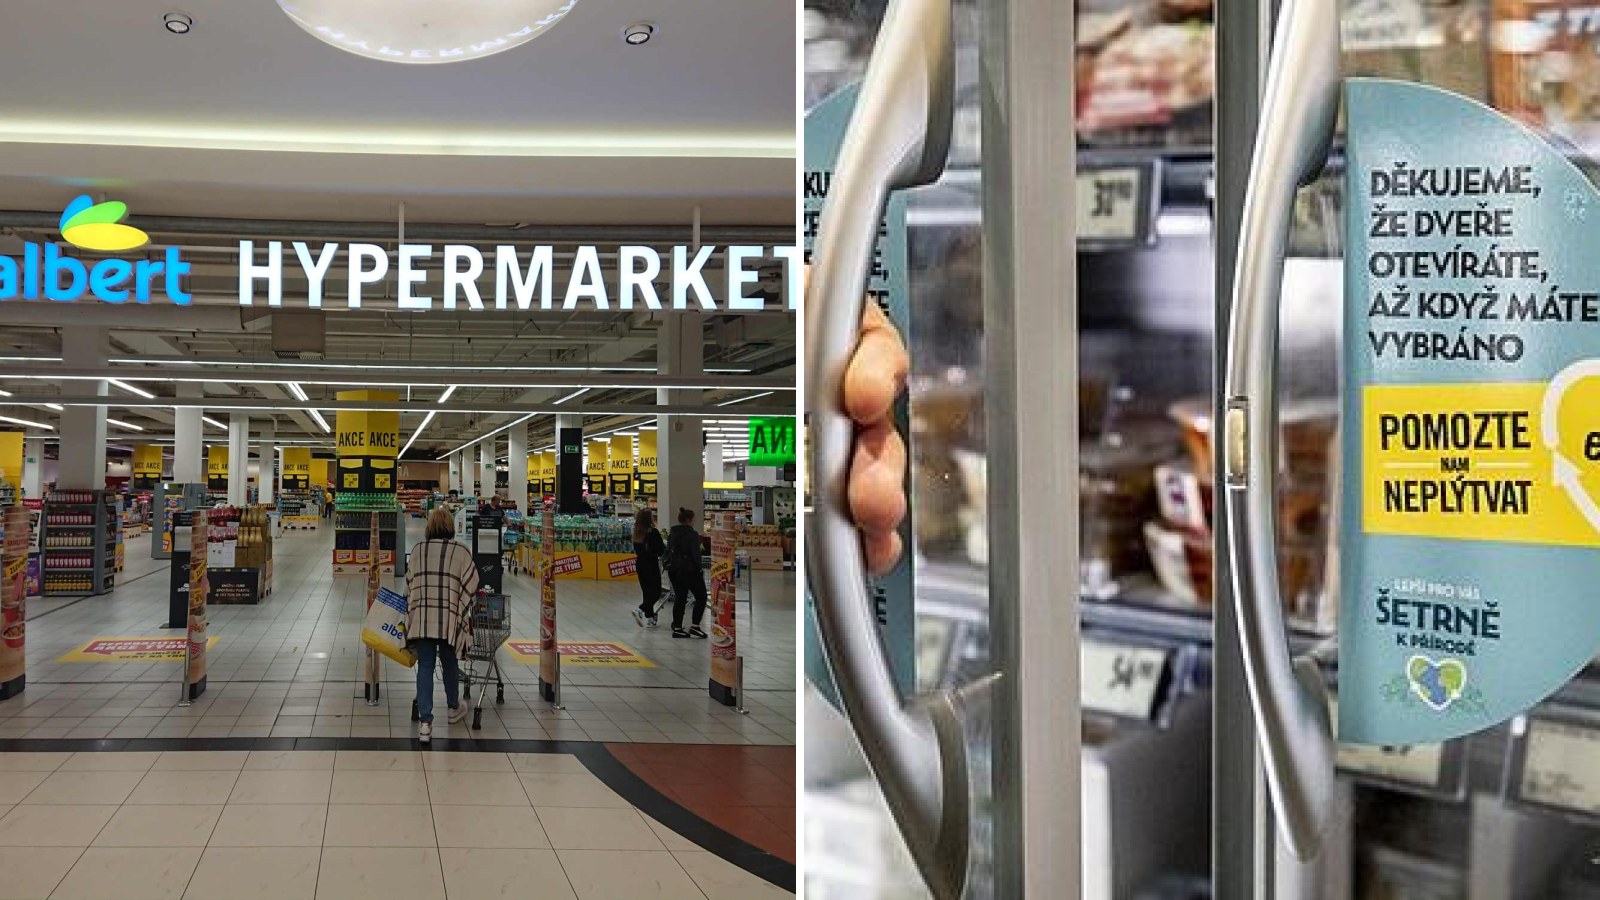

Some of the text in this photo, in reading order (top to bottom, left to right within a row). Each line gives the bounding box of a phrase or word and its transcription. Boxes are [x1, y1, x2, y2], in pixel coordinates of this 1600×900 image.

[1370, 161, 1542, 198] DĚKUJEME,
[1369, 202, 1513, 237] ŽE DVEŘE
[0, 241, 191, 306] albert
[238, 239, 796, 310] HYPERMARKET
[1368, 243, 1548, 283] OTEVÍRÁTE,
[1368, 285, 1600, 322] AŽ KDYŽ MÁTE
[1368, 326, 1524, 362] VYBRÁNO
[338, 432, 396, 448] AKCE AKCE
[1379, 411, 1532, 450] POMOZTE
[612, 460, 629, 469] AKCE
[640, 457, 657, 467] AKC
[1384, 474, 1533, 514] NEPLÝTVAT
[381, 622, 404, 640] albe
[1376, 588, 1501, 639] ŠETRNĚ
[1396, 632, 1408, 646] K
